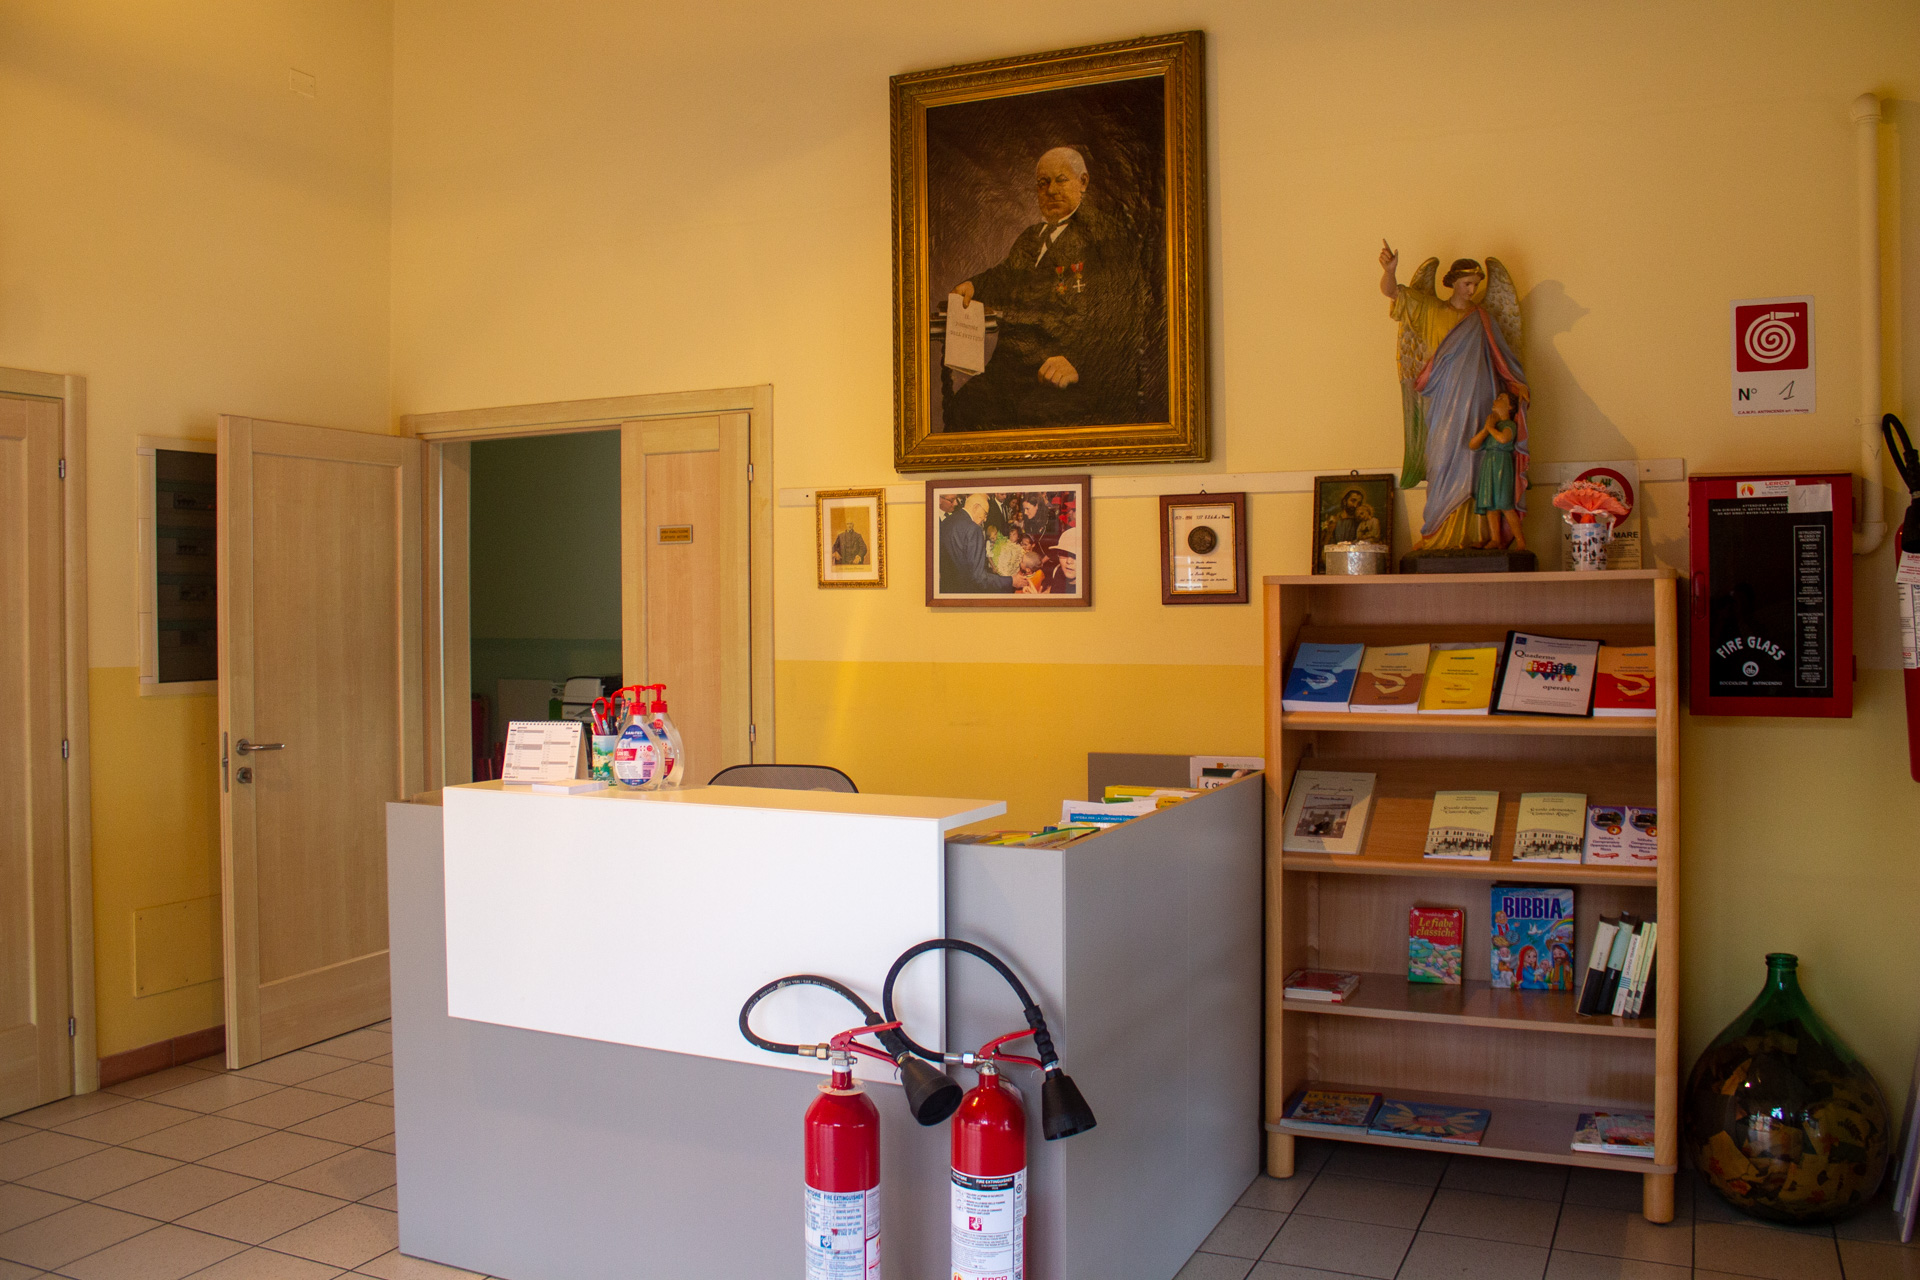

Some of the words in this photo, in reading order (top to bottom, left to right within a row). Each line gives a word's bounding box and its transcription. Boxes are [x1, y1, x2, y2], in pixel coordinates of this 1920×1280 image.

[1779, 380, 1795, 400] 1
[1613, 531, 1640, 540] MARE
[1715, 637, 1744, 659] FIRE
[1747, 636, 1786, 661] GLASS
[1514, 649, 1556, 661] Quaderno
[1502, 896, 1564, 920] BIBBIA
[1419, 917, 1431, 927] Le
[1432, 917, 1454, 928] fiabe
[1416, 927, 1456, 938] classiche
